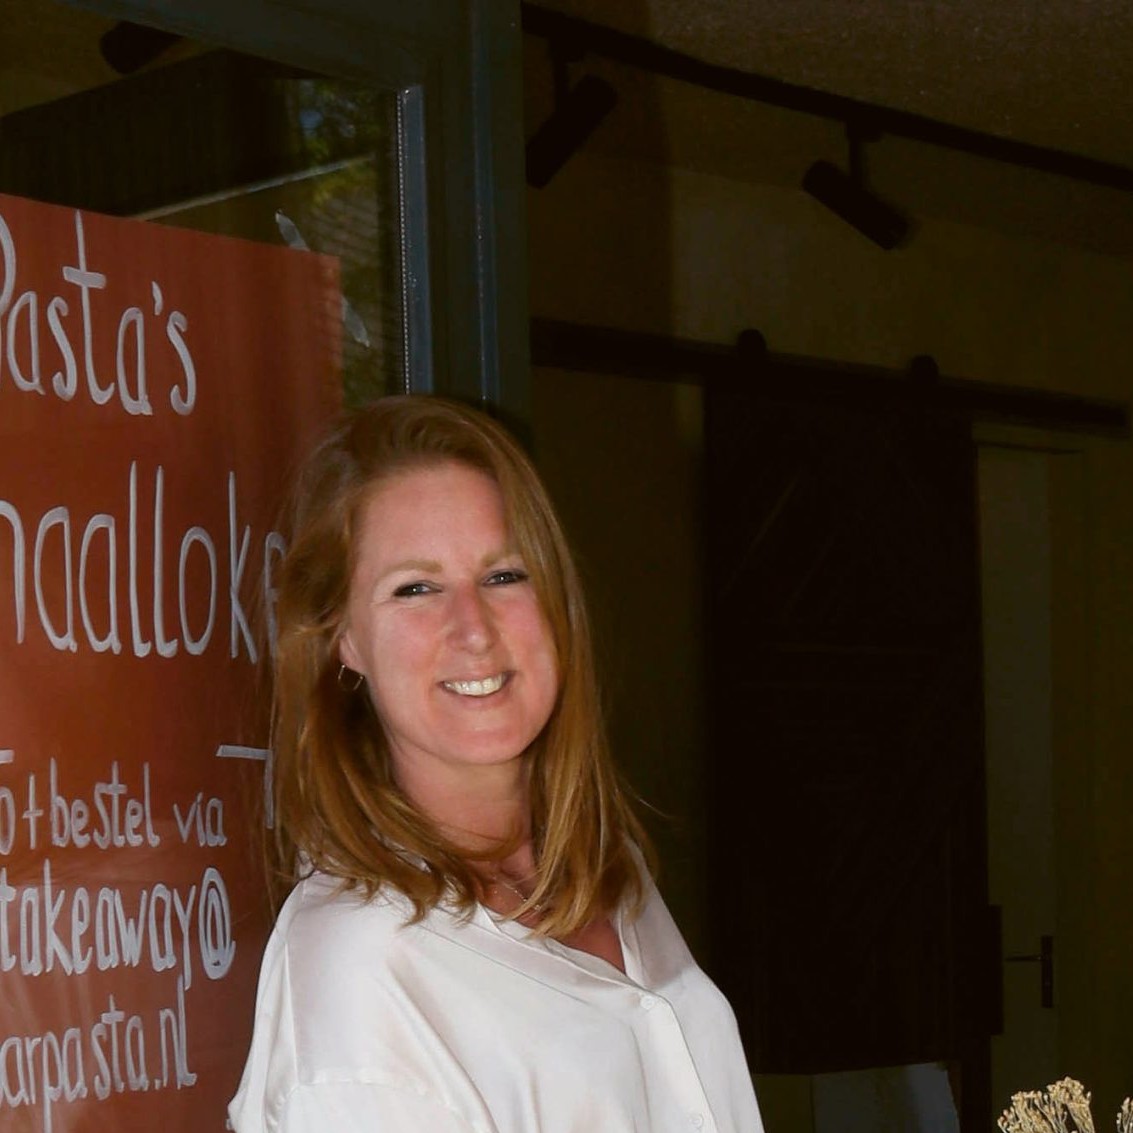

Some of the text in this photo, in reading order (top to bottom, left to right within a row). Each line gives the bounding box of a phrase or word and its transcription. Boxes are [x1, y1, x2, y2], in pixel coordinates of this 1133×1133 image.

[50, 757, 160, 850] bestel
[173, 792, 228, 847] via
[0, 858, 237, 991] takeaway@
